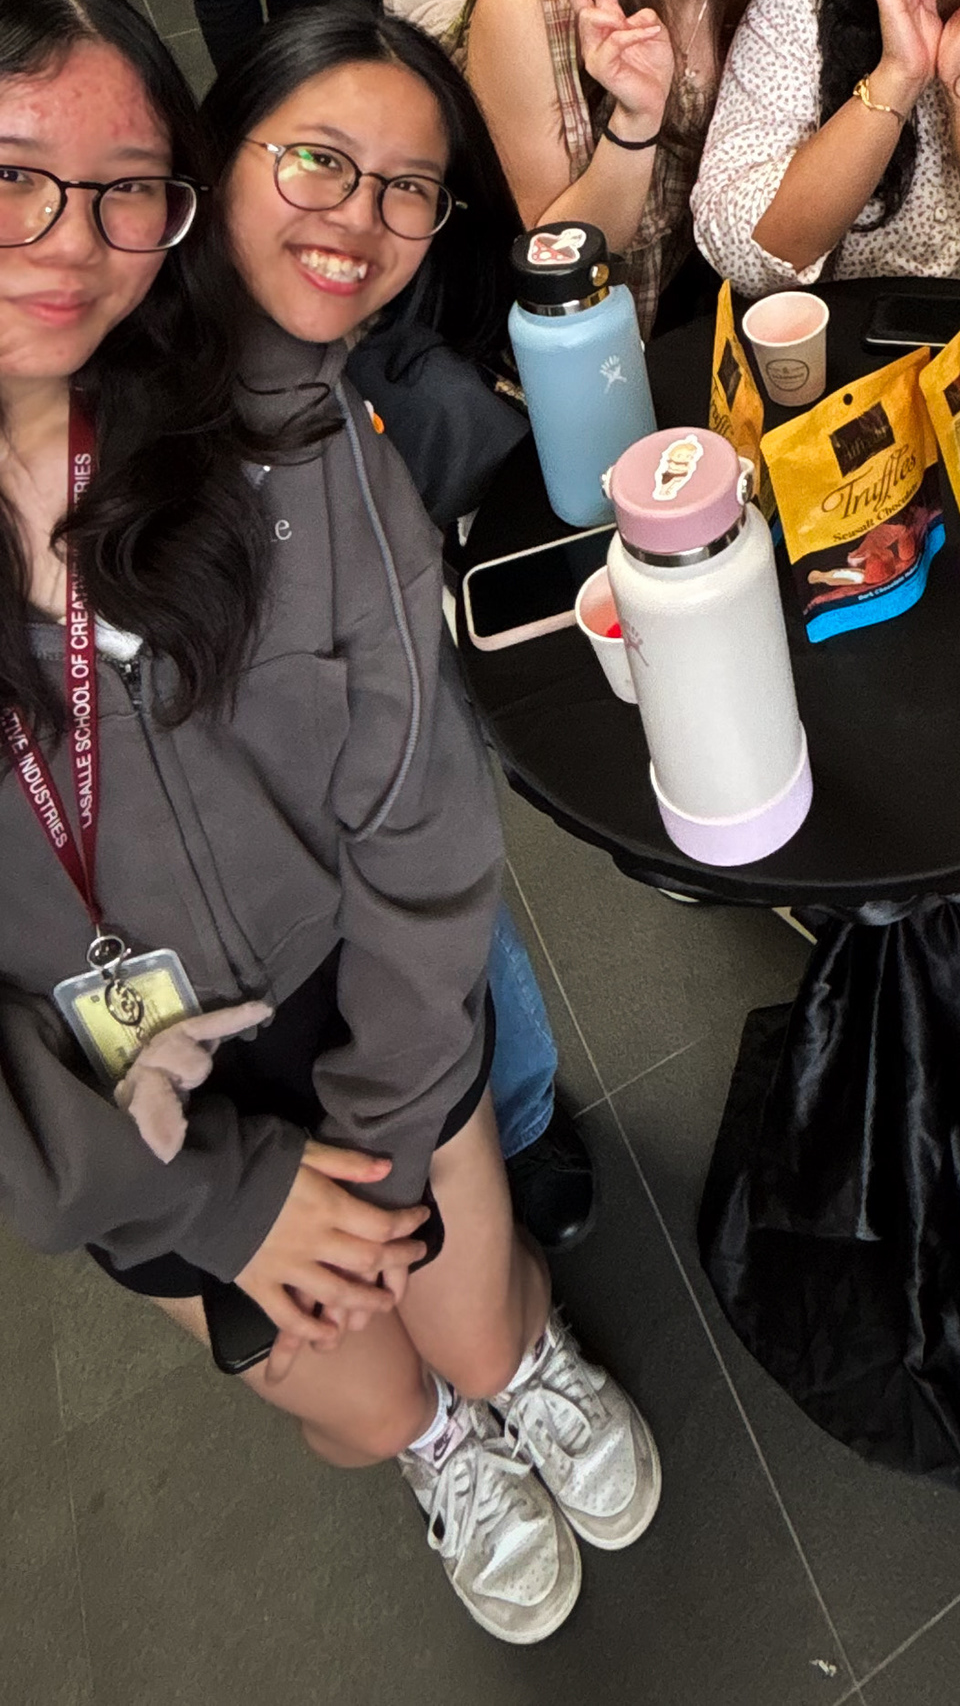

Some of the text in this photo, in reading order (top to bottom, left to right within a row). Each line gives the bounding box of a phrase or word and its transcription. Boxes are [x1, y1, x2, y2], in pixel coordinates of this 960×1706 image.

[821, 443, 917, 520] Truffles
[70, 562, 89, 650] CREAT
[71, 654, 90, 679] OF
[72, 680, 92, 752] SCHOOL
[19, 752, 68, 848] INDUSTRIES
[77, 753, 93, 829] LASALLE
